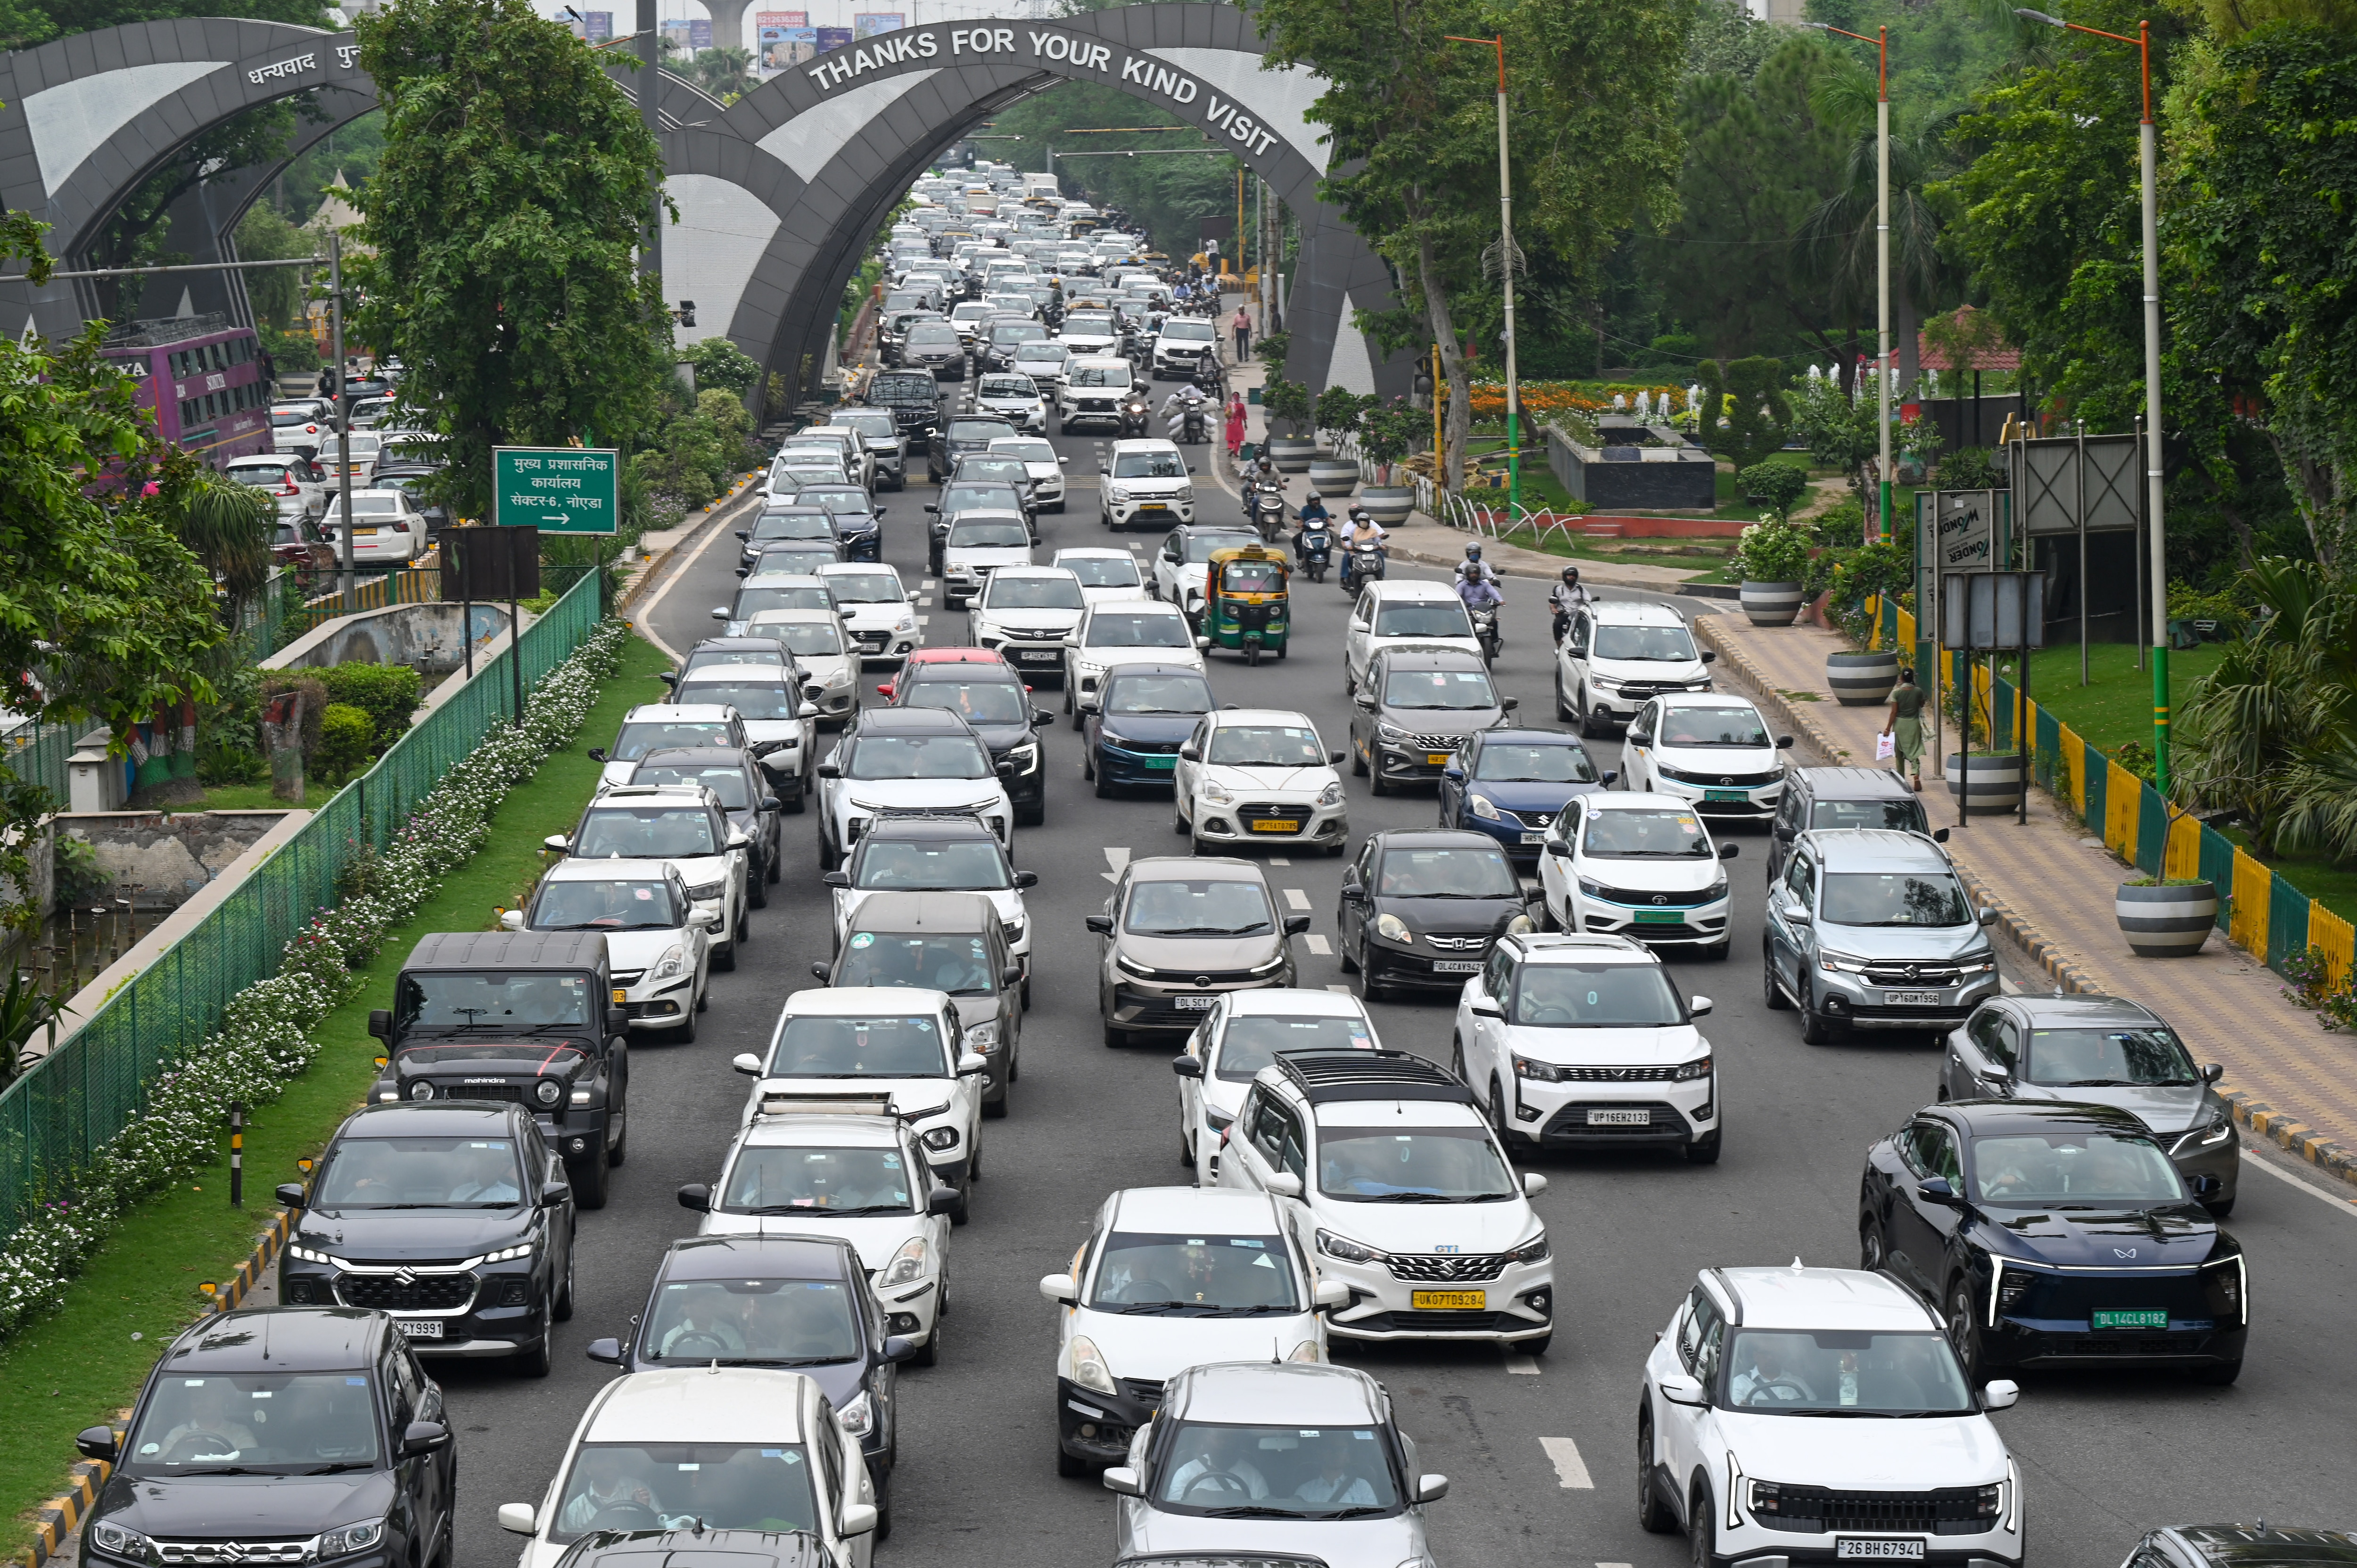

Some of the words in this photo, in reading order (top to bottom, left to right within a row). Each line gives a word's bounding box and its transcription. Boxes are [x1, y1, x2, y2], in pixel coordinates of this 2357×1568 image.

[248, 53, 316, 84] धन्यवाद
[808, 33, 938, 90] THANKS
[952, 28, 1015, 55] FOR
[1028, 32, 1111, 72] YOUR
[1121, 56, 1197, 103] KIND
[1207, 95, 1278, 156] VISIT
[513, 459, 541, 473] मुख्य
[548, 457, 608, 470] प्रशासनिक
[531, 475, 581, 489] कार्यालय
[510, 492, 561, 508] सेक्टर-6,
[566, 494, 602, 510] नोएडा
[1180, 998, 1190, 1006] DL
[1193, 998, 1207, 1007] 5CY
[1593, 1113, 1648, 1122] UP16EH2133
[1435, 1245, 1459, 1253] GTi
[1419, 1294, 1484, 1306] UK07TD9284
[2100, 1314, 2166, 1325] DL14CL8182
